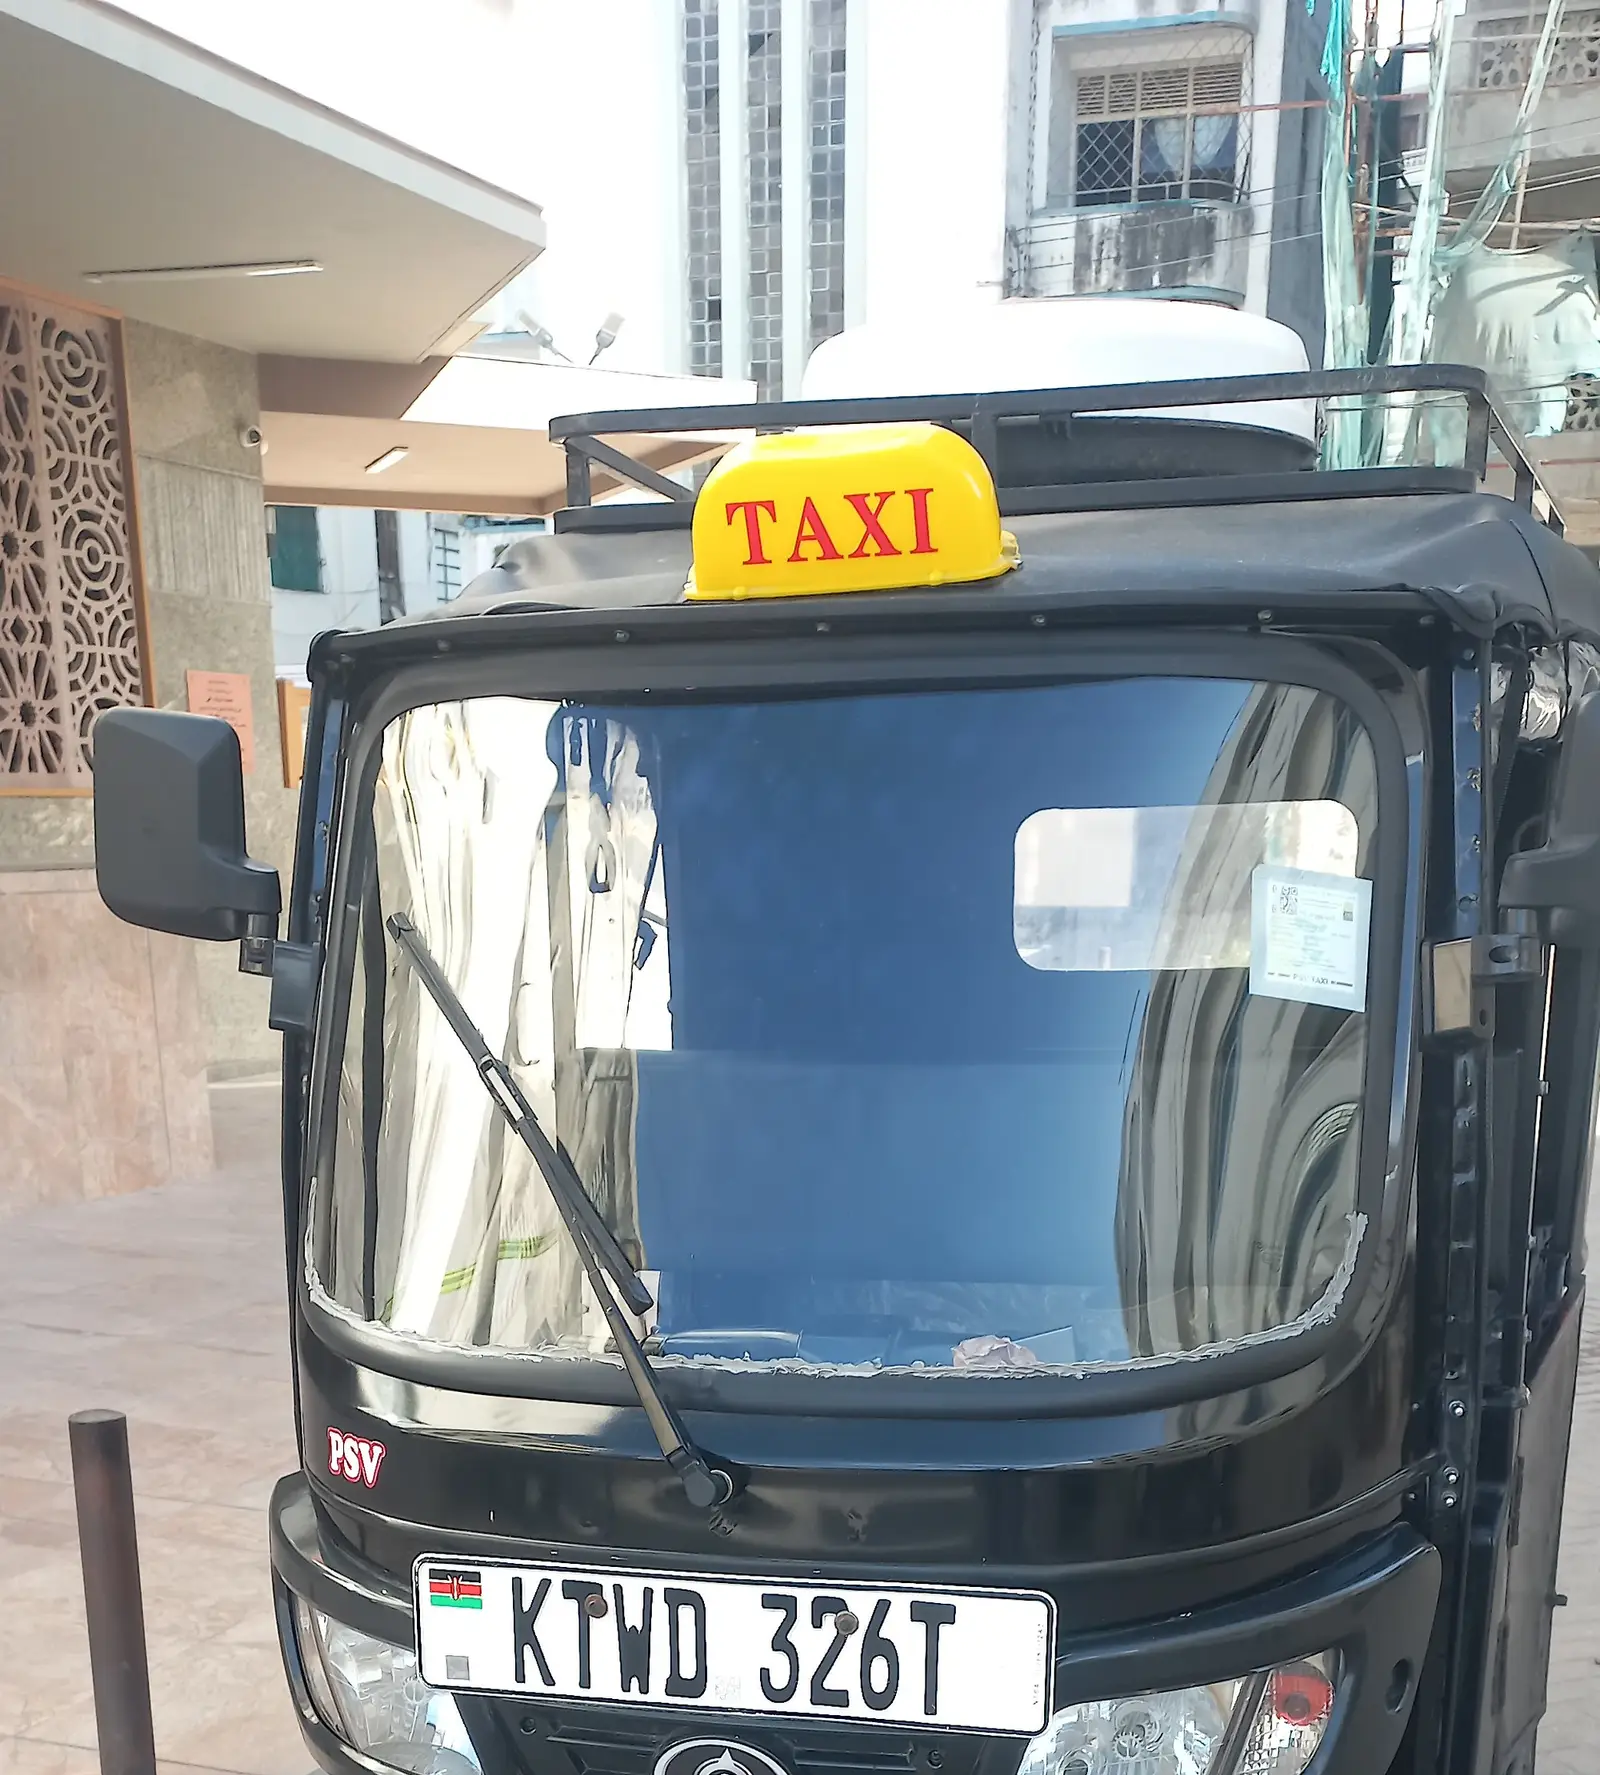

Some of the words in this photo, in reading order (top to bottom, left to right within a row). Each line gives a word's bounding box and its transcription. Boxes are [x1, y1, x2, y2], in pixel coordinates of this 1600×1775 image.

[725, 488, 938, 565] TAXI
[327, 1427, 386, 1488] PSV
[511, 1576, 708, 1699] KTWD
[760, 1592, 957, 1716] 326T
